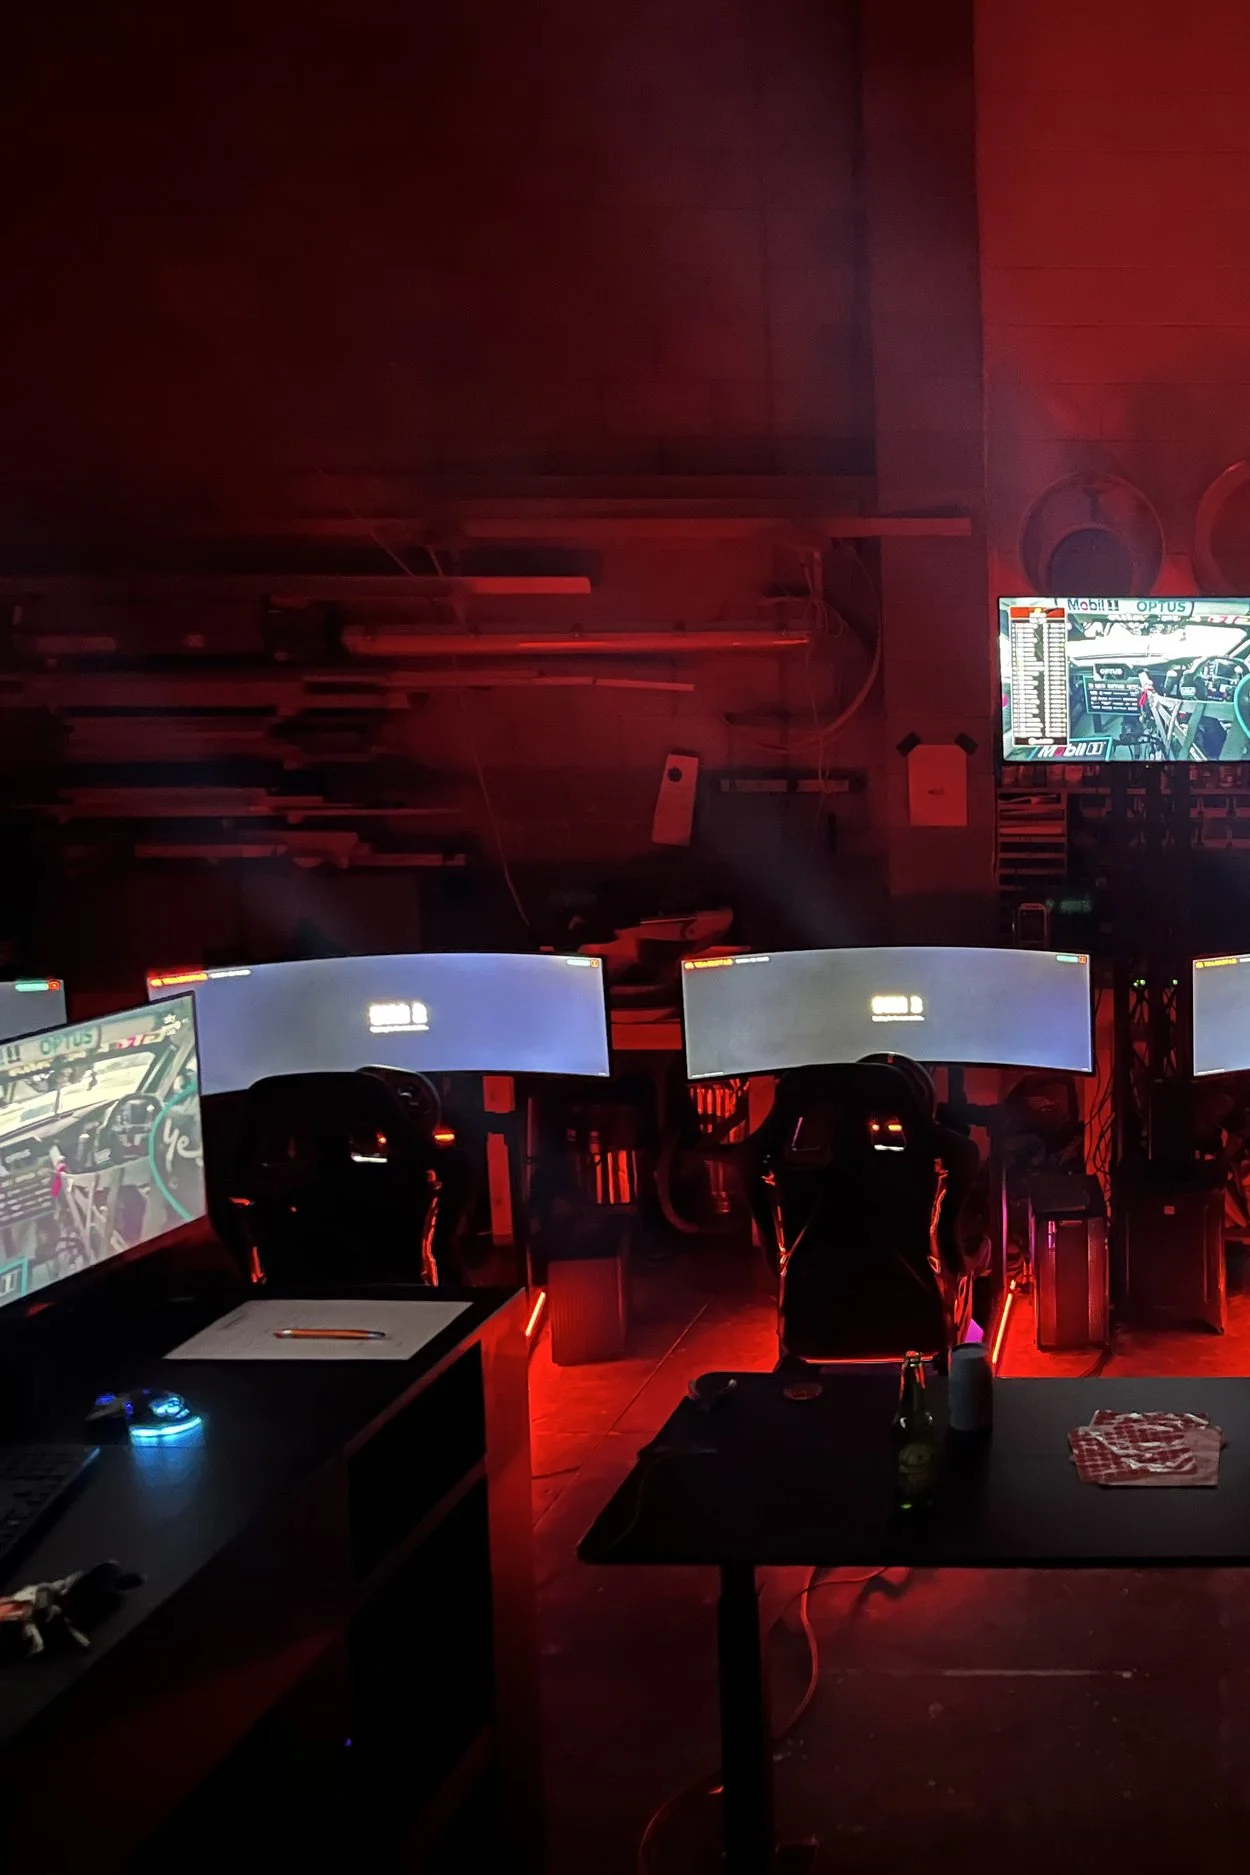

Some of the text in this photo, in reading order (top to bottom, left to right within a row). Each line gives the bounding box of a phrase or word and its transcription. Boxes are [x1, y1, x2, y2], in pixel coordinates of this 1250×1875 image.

[1067, 599, 1105, 611] Mobil
[1136, 599, 1187, 613] OPTUS
[1037, 742, 1087, 758] Mobil
[38, 1028, 95, 1056] OPTUS
[162, 1117, 204, 1176] ye
